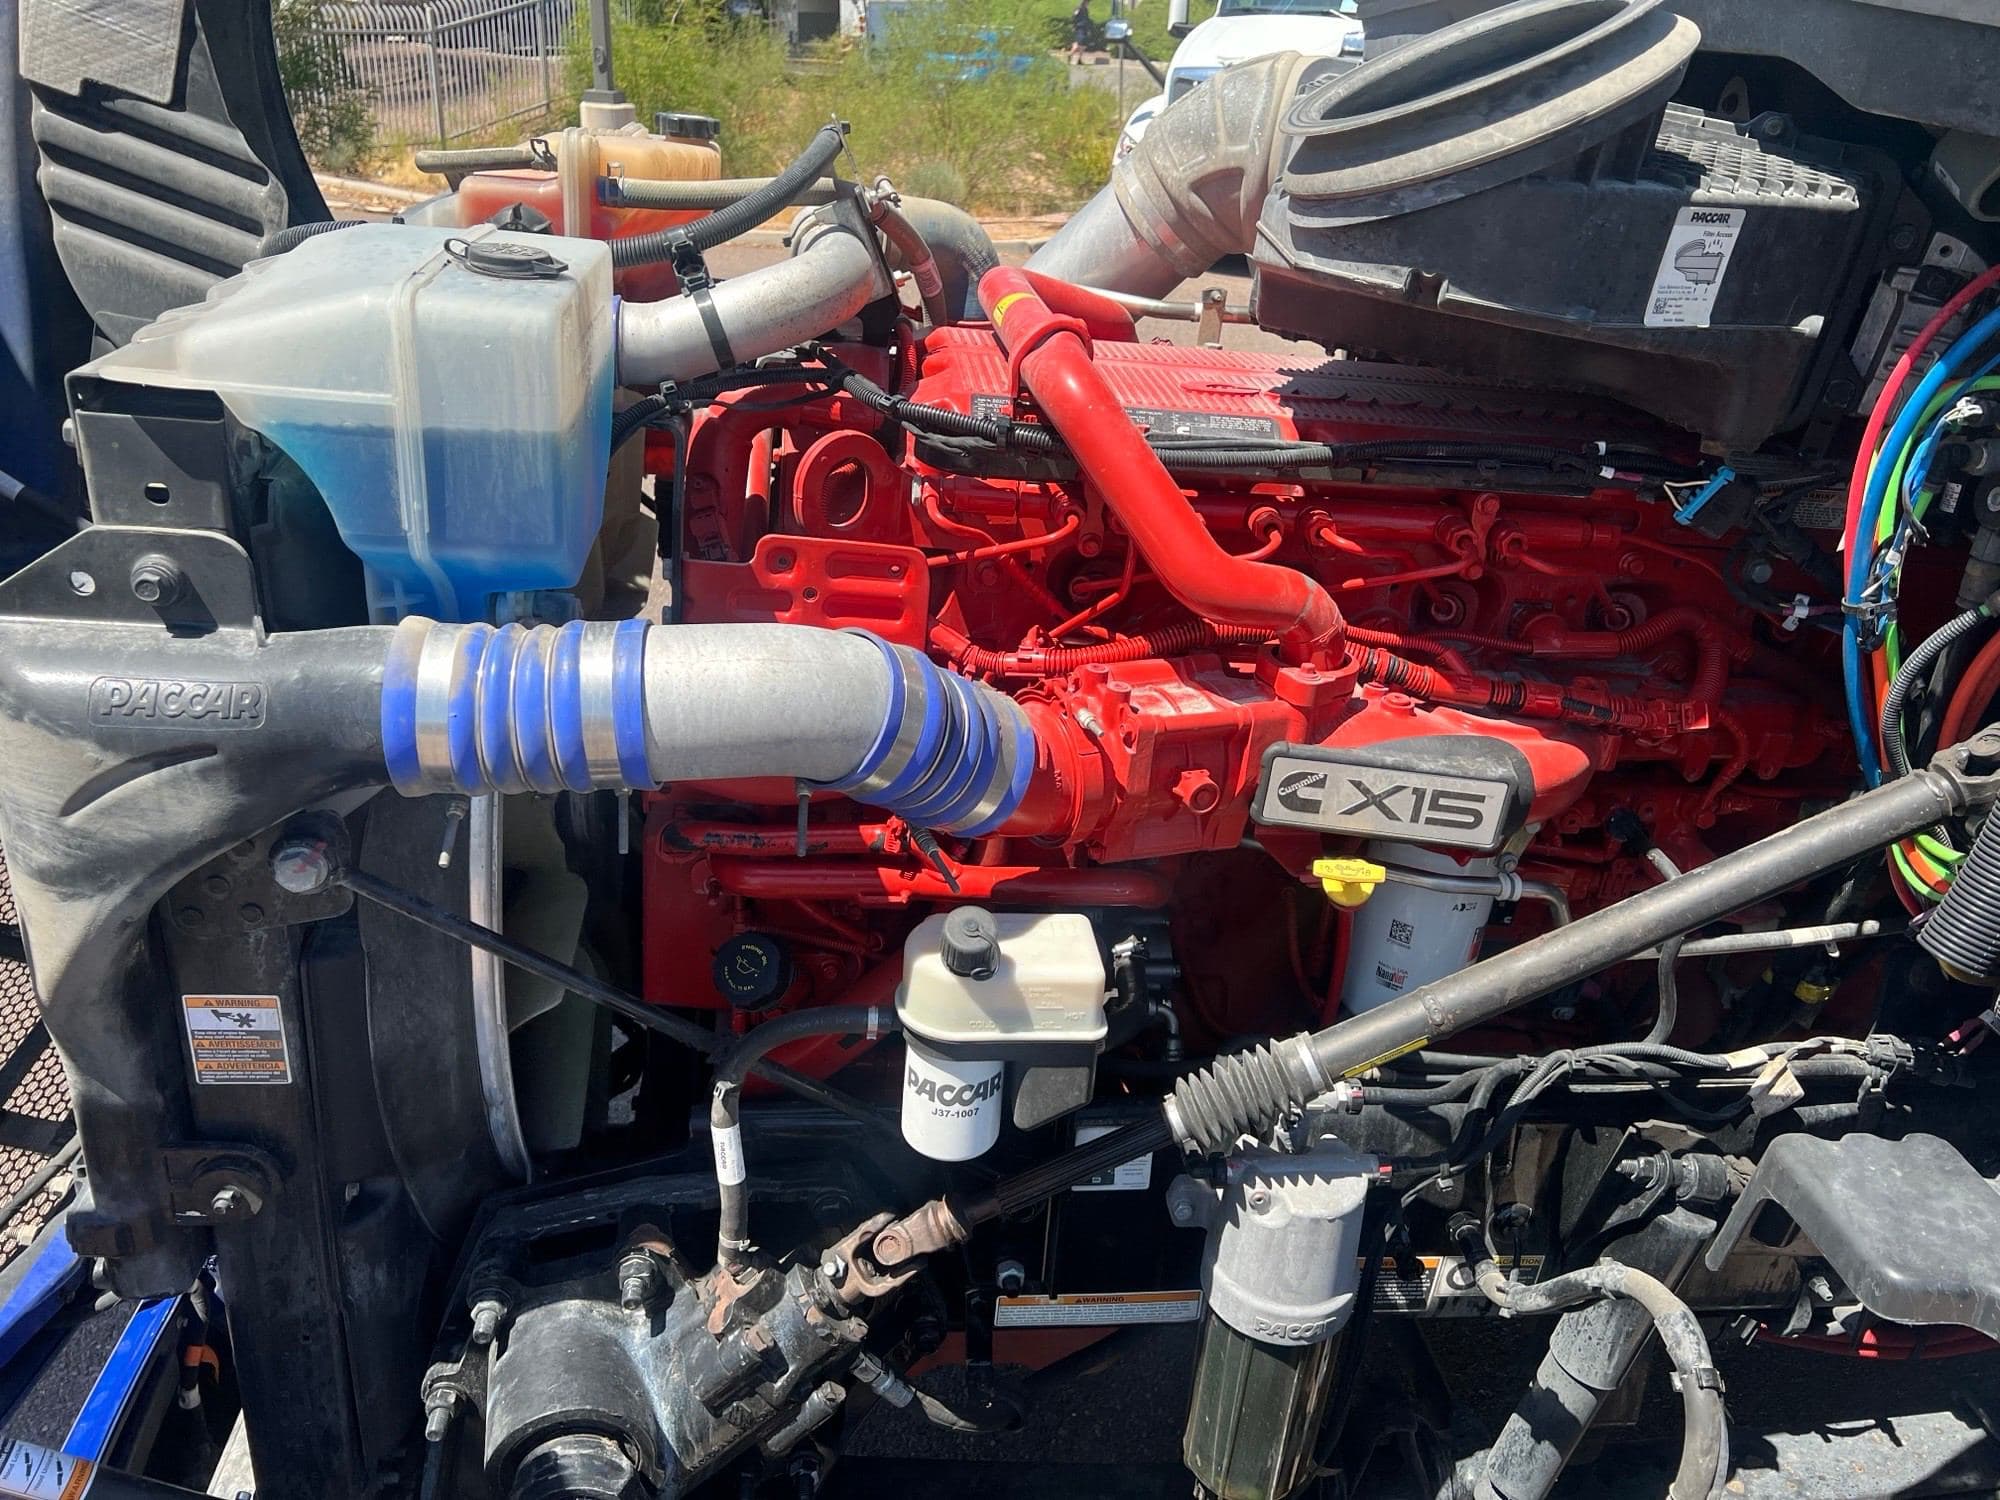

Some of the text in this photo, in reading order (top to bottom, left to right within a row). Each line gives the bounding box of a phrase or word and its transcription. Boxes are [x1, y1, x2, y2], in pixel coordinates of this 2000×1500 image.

[1690, 212, 1731, 224] PACCAR
[1703, 230, 1716, 238] Filter
[100, 679, 262, 720] PACCAR
[1278, 772, 1326, 797] Cummins
[1336, 778, 1487, 831] X15
[215, 999, 260, 1007] WARNING
[908, 1064, 1001, 1107] PACCAR
[931, 1107, 980, 1119] J37-1007
